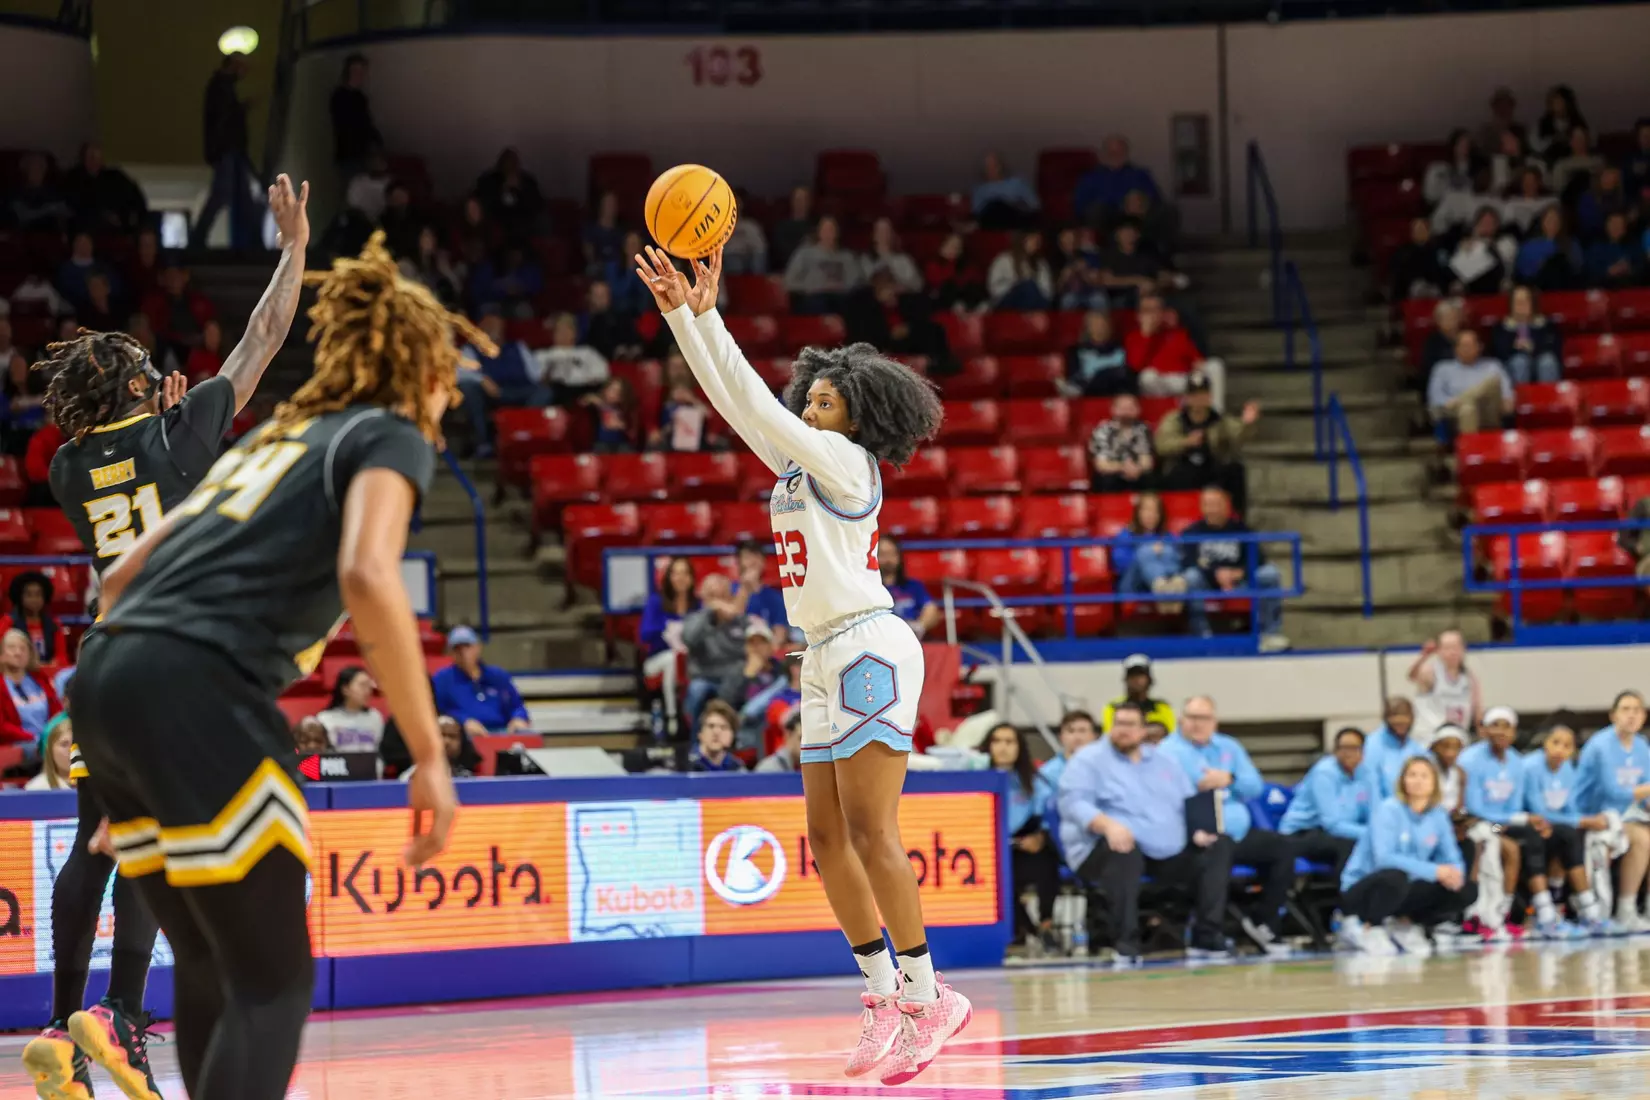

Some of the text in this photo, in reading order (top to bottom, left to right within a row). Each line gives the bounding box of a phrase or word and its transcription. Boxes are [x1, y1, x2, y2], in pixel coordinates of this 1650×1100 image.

[683, 45, 765, 88] 103
[82, 482, 164, 558] 21
[329, 846, 542, 913] Kubota
[597, 885, 696, 914] Kubota
